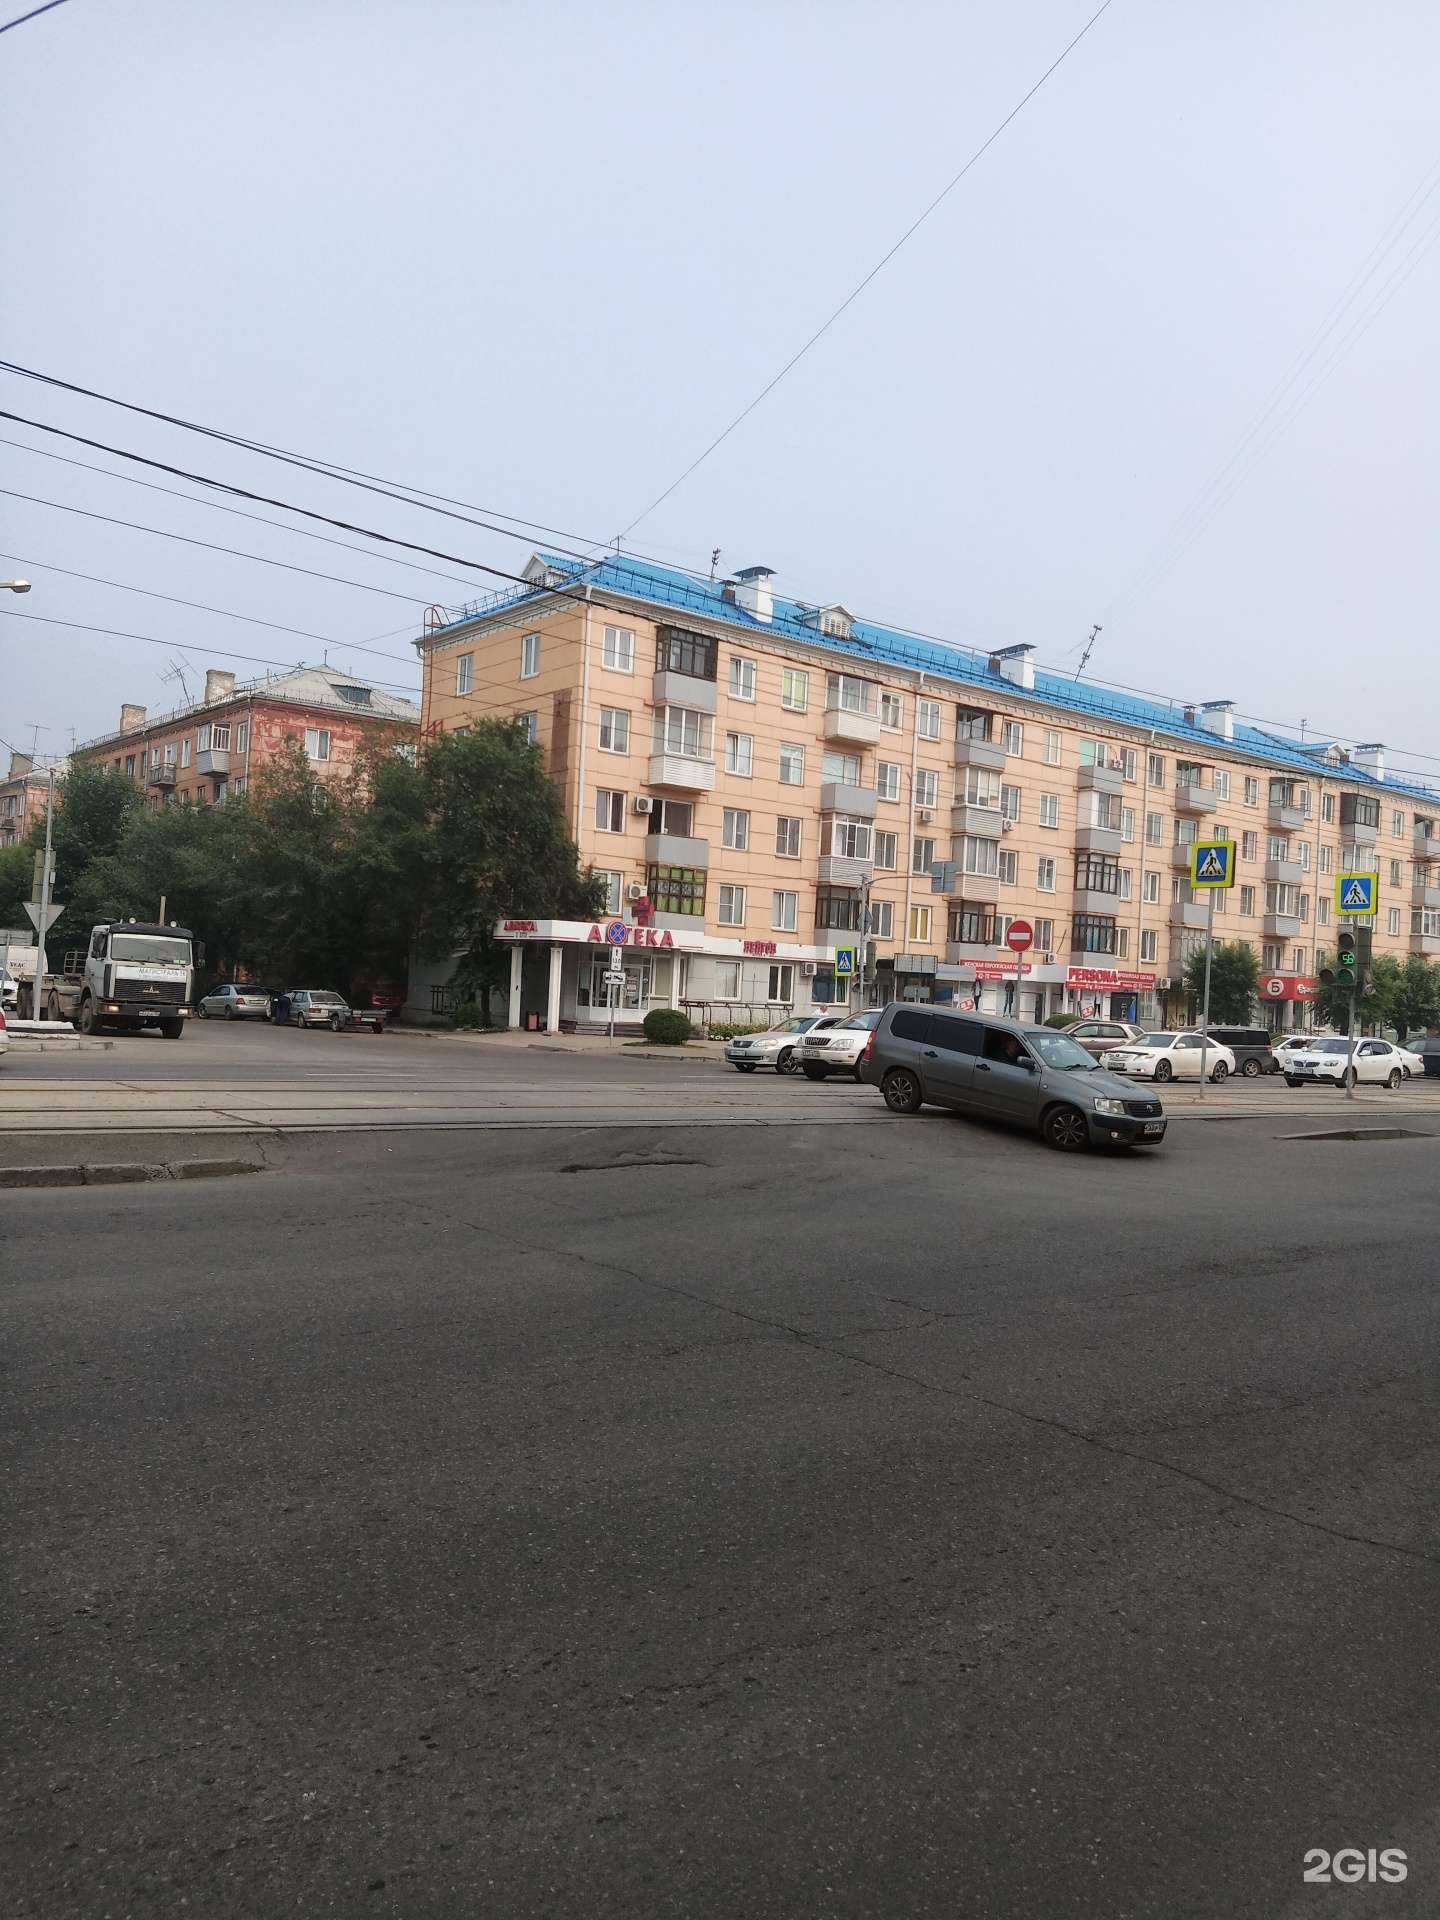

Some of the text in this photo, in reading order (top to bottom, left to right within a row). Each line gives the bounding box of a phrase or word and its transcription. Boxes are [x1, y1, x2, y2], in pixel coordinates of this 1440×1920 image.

[587, 924, 674, 948] АТЕКА
[1342, 953, 1355, 965] 56
[1068, 967, 1119, 983] PERSONA
